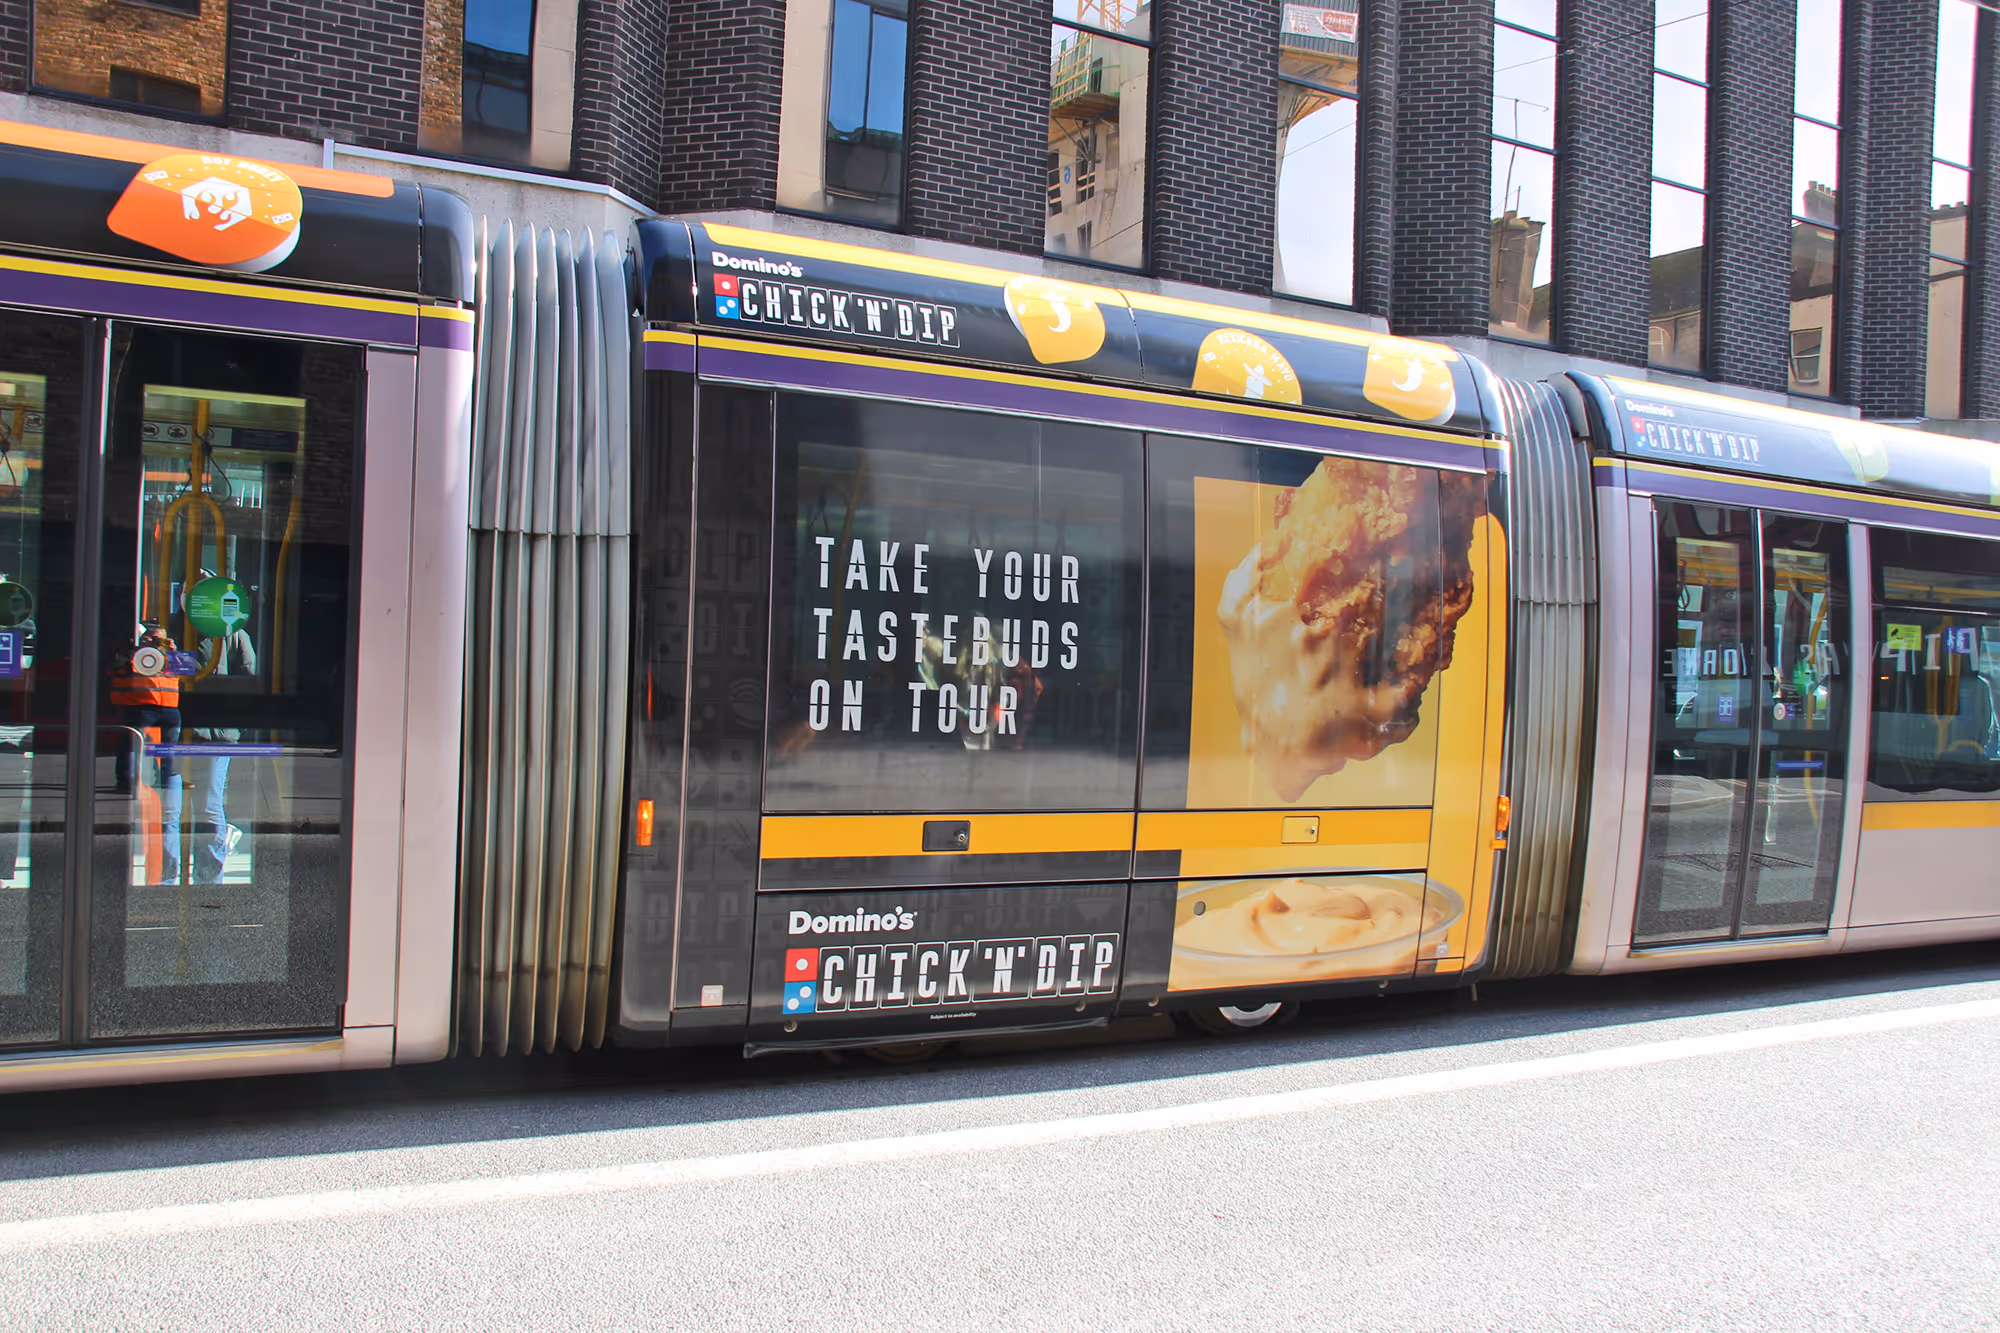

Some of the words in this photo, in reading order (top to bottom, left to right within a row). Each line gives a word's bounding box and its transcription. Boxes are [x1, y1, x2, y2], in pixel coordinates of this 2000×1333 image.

[711, 251, 803, 278] Domino's
[742, 283, 849, 328] CHICK
[857, 298, 888, 332] 'N'
[900, 304, 955, 342] DIP
[1645, 422, 1705, 454] CHICK
[1726, 435, 1760, 462] DIP
[815, 536, 930, 594] TAKE
[974, 548, 1079, 604] YOUR
[813, 607, 1079, 670] TASTEBUDS
[808, 679, 864, 731] ON
[908, 682, 1017, 735] TOUR
[788, 905, 915, 935] Domino's
[821, 948, 970, 1005] CHICK
[983, 945, 1026, 994] 'N'
[1036, 941, 1114, 991] DIP
